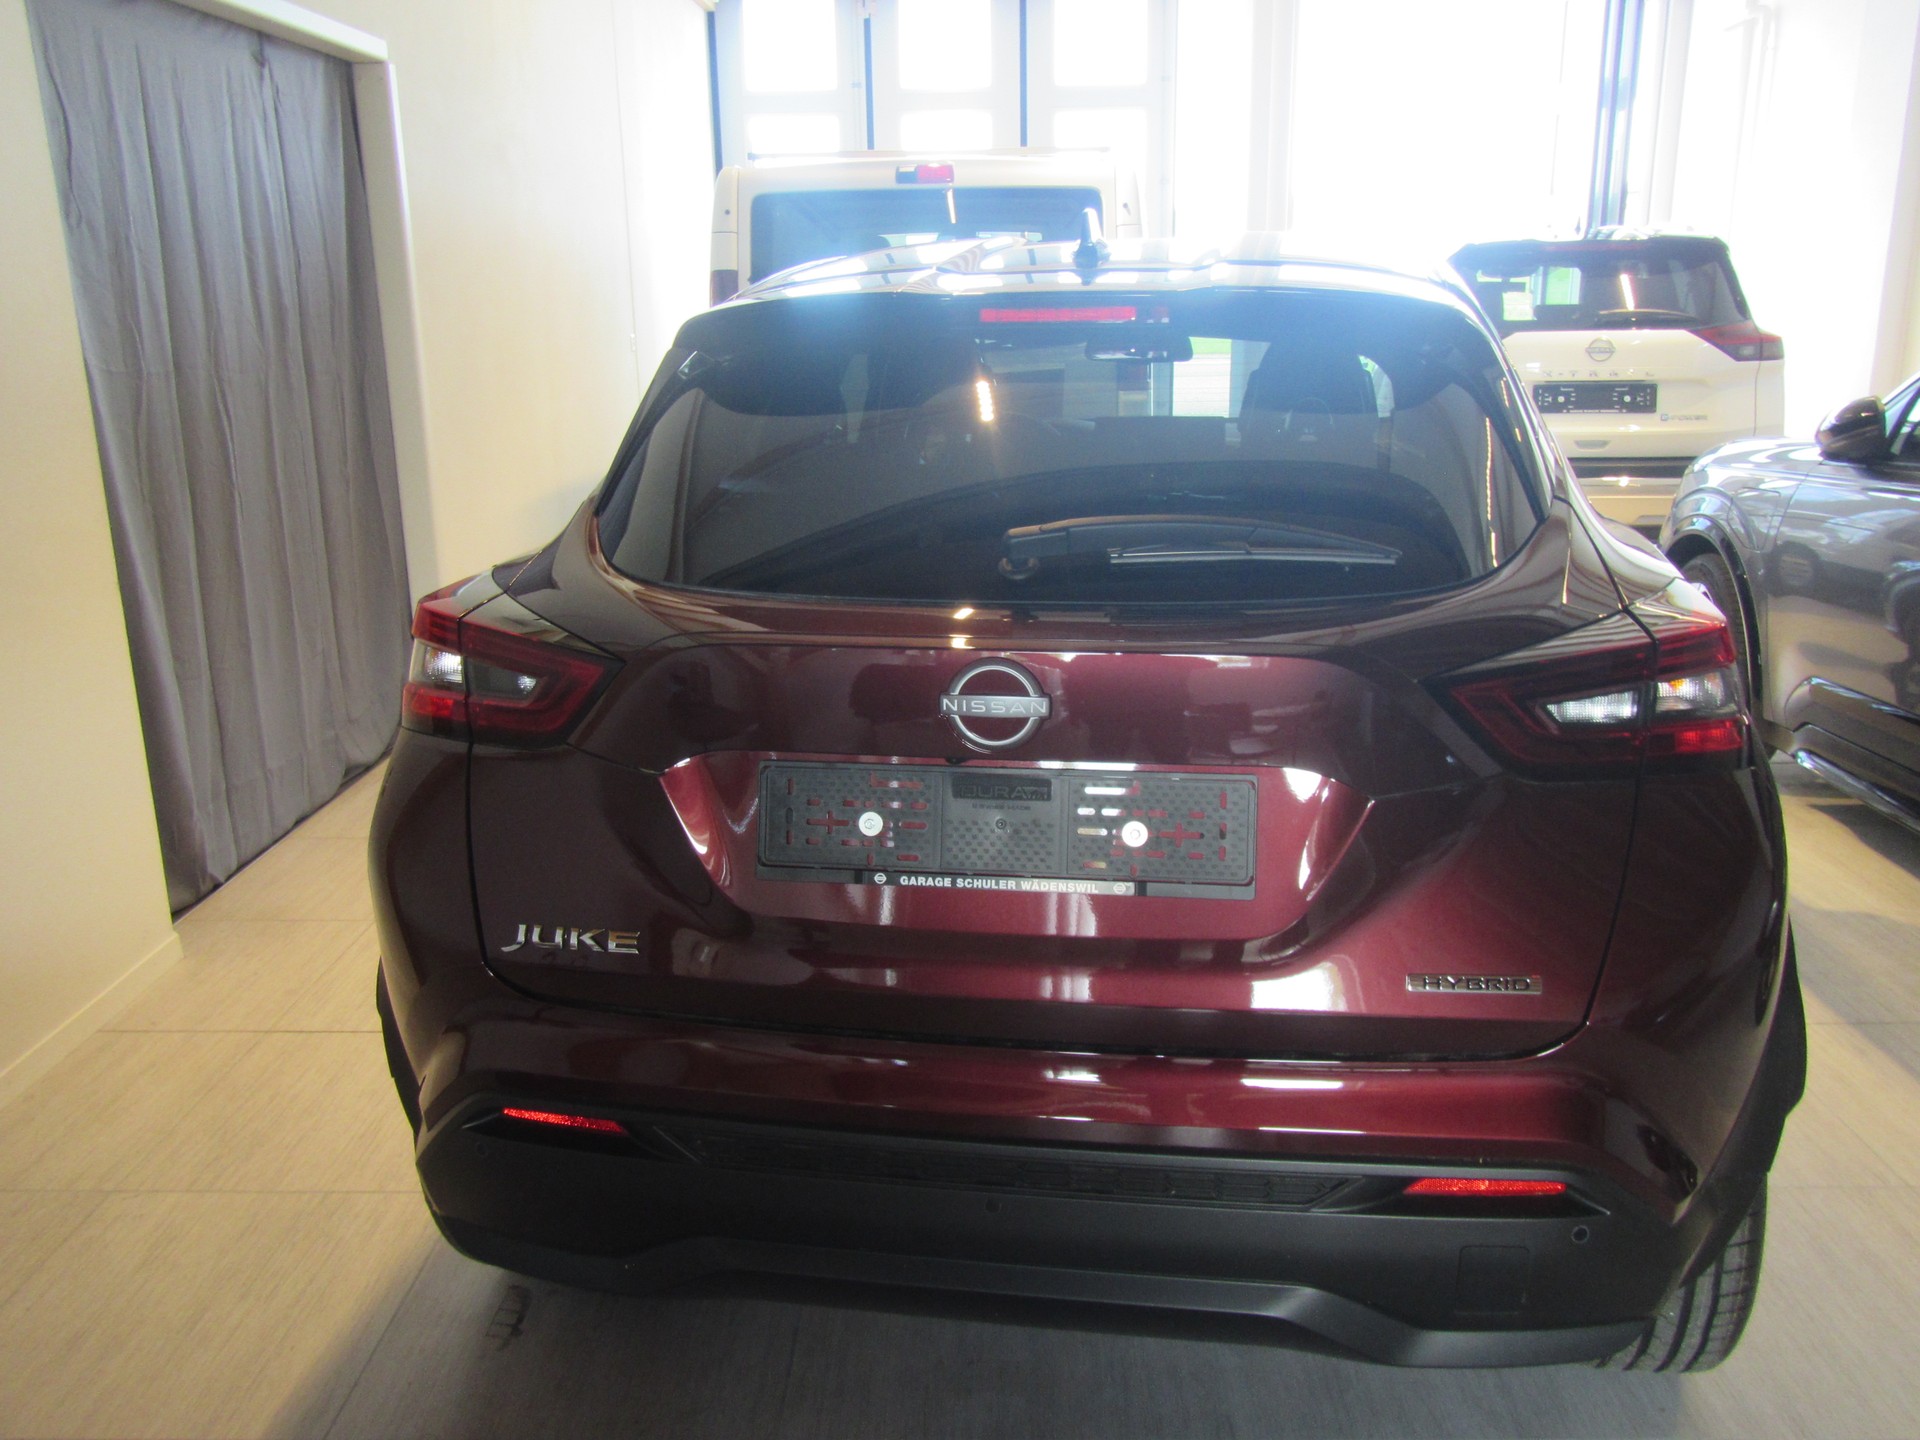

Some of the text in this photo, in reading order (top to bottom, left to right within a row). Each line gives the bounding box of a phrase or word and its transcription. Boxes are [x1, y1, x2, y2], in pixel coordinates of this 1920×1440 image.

[943, 698, 1047, 714] NISSAN
[900, 875, 1099, 894] GARAGE SCHULER WÄDENSWIL
[500, 923, 641, 955] JUKE
[1423, 975, 1531, 991] HYBRID
